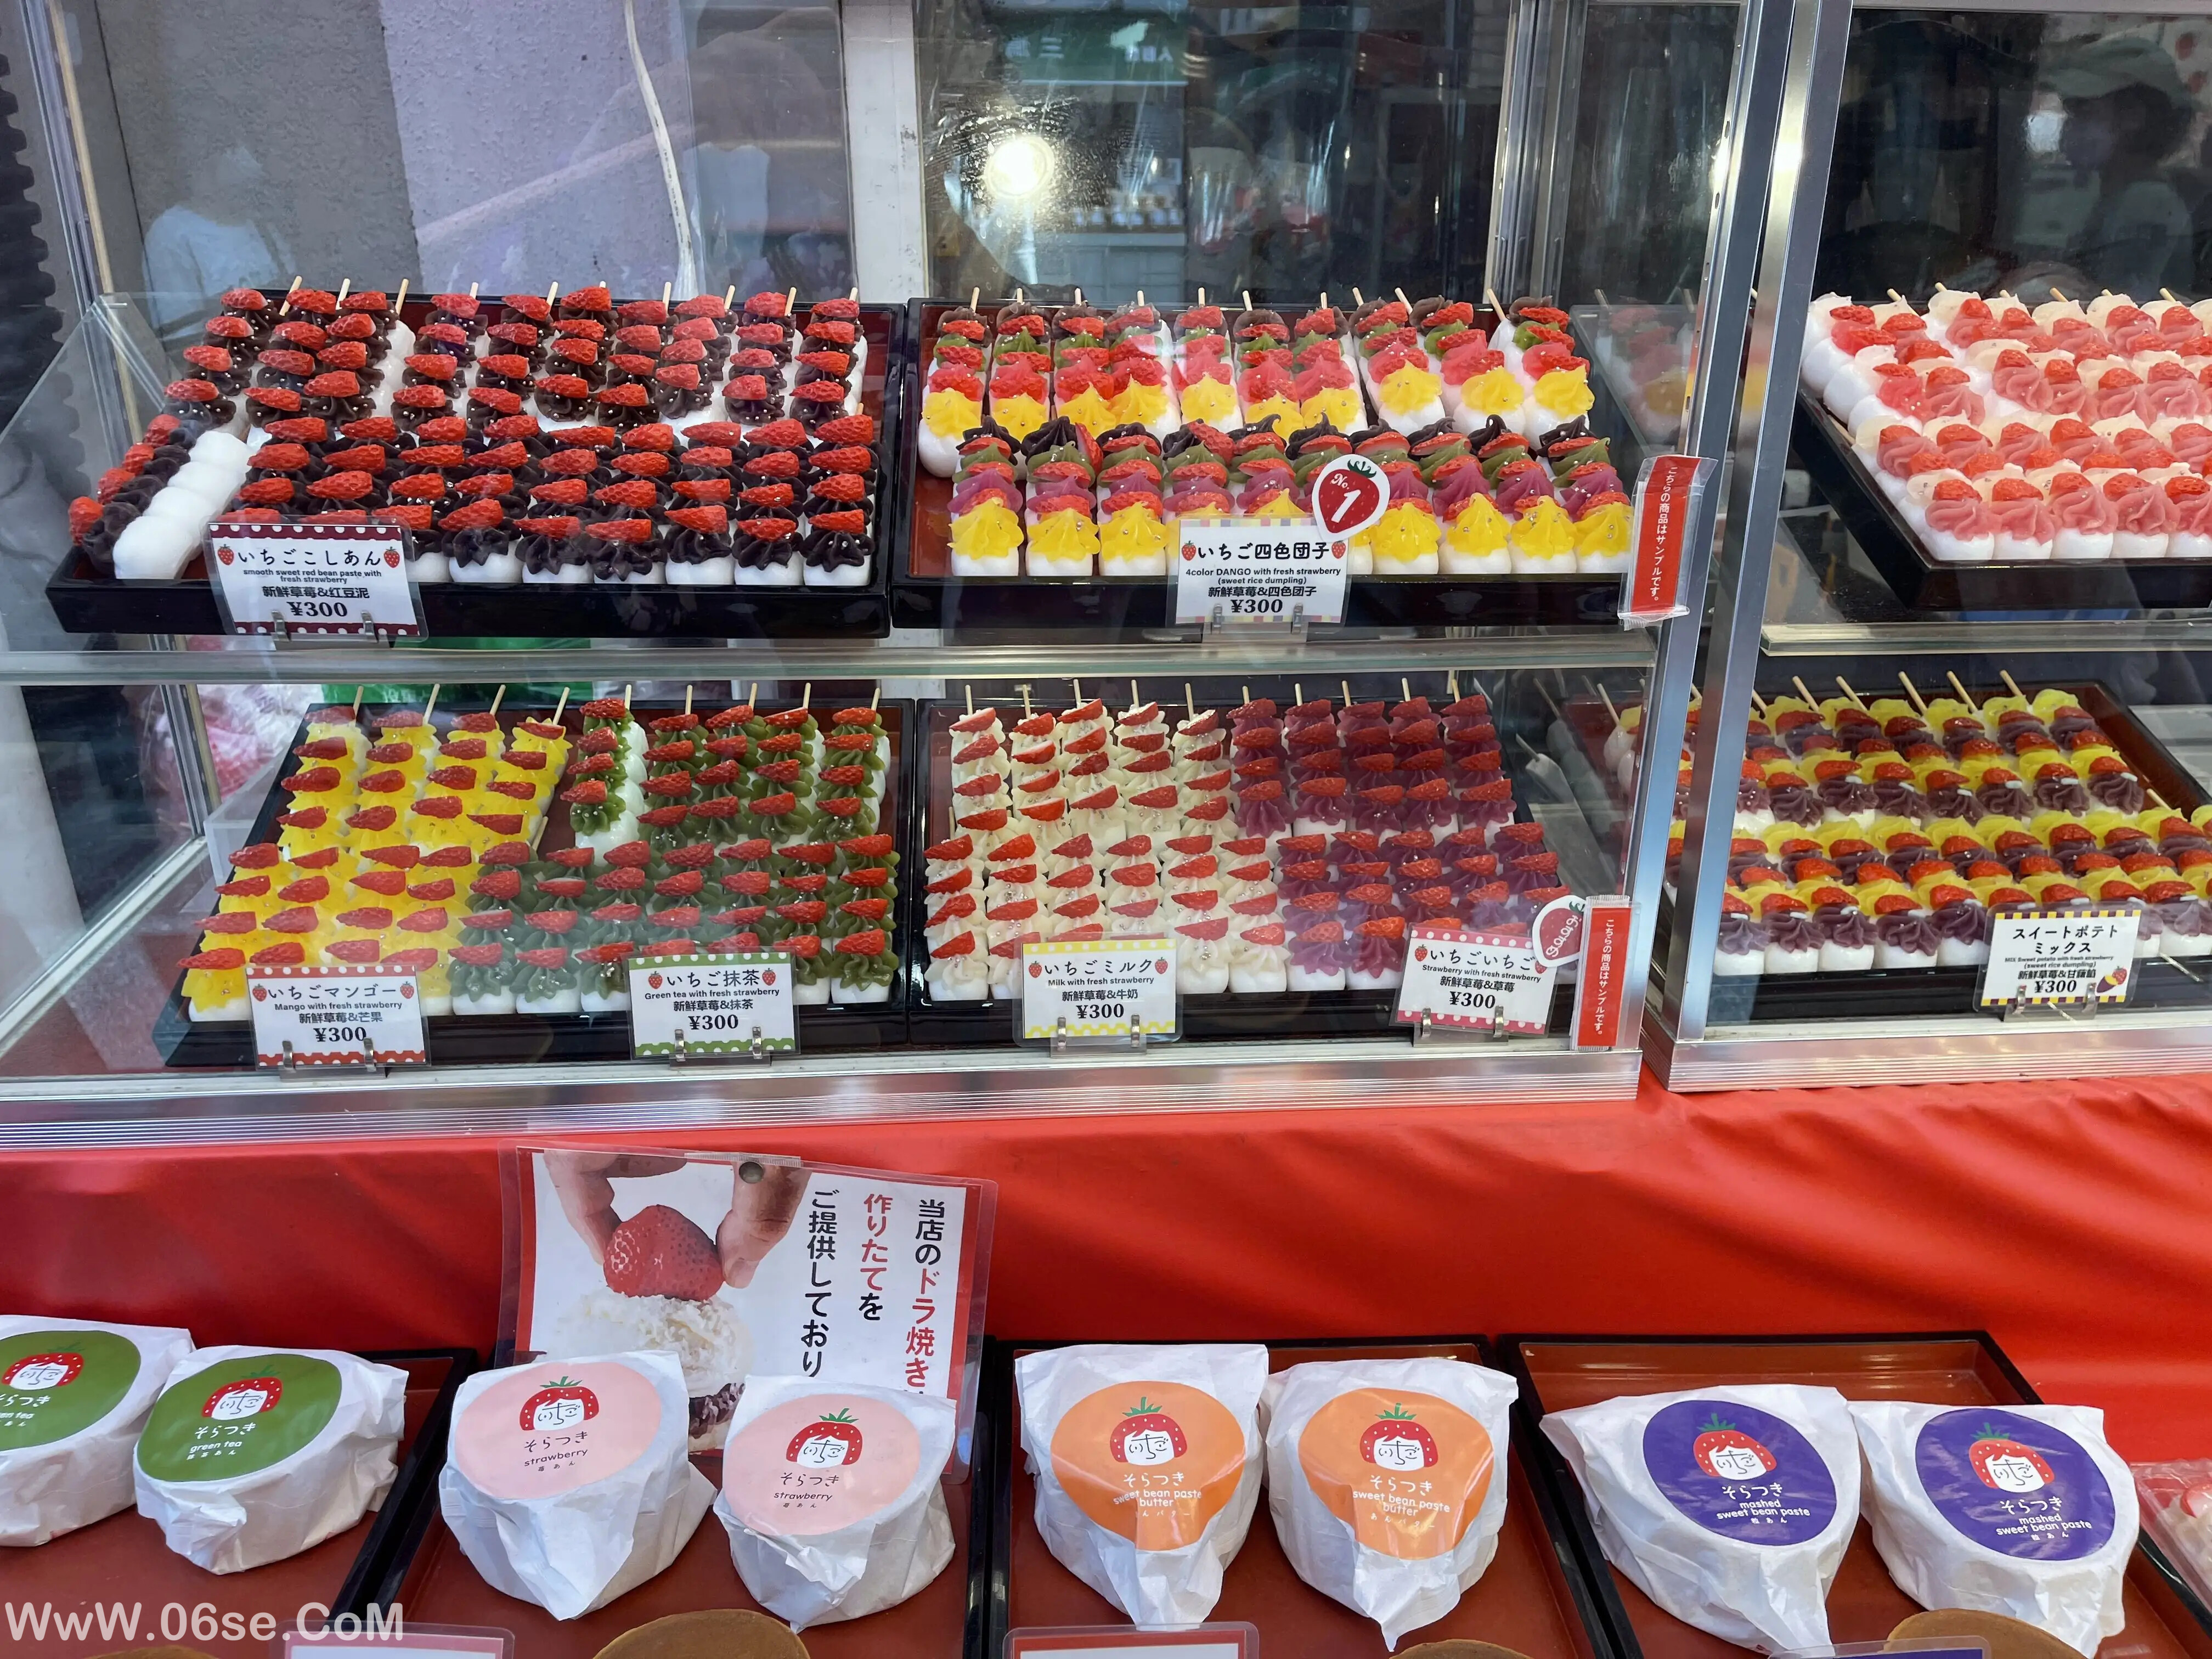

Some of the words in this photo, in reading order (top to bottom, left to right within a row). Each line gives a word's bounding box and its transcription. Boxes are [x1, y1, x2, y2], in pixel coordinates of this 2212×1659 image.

[1331, 472, 1350, 490] No.
[1330, 489, 1361, 523] 1
[1650, 466, 1678, 601] こちらの商品はサンプルです。
[238, 548, 381, 566] いちごこしあん
[1198, 541, 1329, 561] いちご四色団子
[1186, 568, 1214, 577] 4color
[1216, 568, 1251, 576] DANGO
[1273, 567, 1294, 575] fresh
[1296, 567, 1341, 576] strawberry
[1218, 577, 1246, 585] (sweet
[1265, 577, 1307, 585] dumpling)
[287, 602, 348, 617] ¥300
[1231, 599, 1283, 613] ¥300
[1546, 915, 1582, 957] おすすめ
[2013, 924, 2118, 939] スイートポテト
[2035, 942, 2091, 955] ミックス
[1045, 958, 1152, 975] いちごミルク
[1430, 948, 1536, 970] いちごいちご
[667, 969, 759, 988] いちご抹茶
[1423, 964, 1462, 975] Strawberry
[1501, 972, 1541, 983] strawberry
[1594, 919, 1614, 1035] こちらの商品はサンプルです。
[268, 983, 396, 1000] いちごマンゴー
[733, 988, 780, 996] strawberry
[2034, 980, 2077, 993] ¥300
[354, 1001, 402, 1010] strawberry
[1449, 991, 1495, 1009] ¥300
[1076, 1003, 1124, 1019] ¥300
[688, 1014, 738, 1030] ¥300
[313, 1026, 366, 1042] ¥300
[859, 1193, 893, 1321] 作りたてを
[800, 1189, 840, 1378] ご提供しており
[905, 1199, 945, 1394] 当店のドラ焼き
[195, 1423, 256, 1439] そらつき
[189, 1443, 221, 1454] green
[524, 1431, 588, 1452] そらつき
[524, 1449, 588, 1466] strawberry
[780, 1472, 839, 1487] そらつき
[1124, 1471, 1184, 1487] そらつき
[1370, 1475, 1432, 1496] そらつき
[774, 1492, 832, 1501] strawberry
[1113, 1490, 1139, 1505] sweet
[1143, 1489, 1170, 1498] bean
[1174, 1490, 1201, 1499] paste
[1722, 1482, 1782, 1500] そらつき
[1139, 1498, 1173, 1507] butter
[1353, 1491, 1385, 1500] sweet
[1389, 1494, 1415, 1506] bean
[1419, 1500, 1450, 1513] paste
[1383, 1503, 1418, 1516] butter
[1739, 1499, 1781, 1509] mashed
[2000, 1496, 2062, 1515] そらつき
[1717, 1509, 1748, 1519] sweet
[1751, 1508, 1778, 1516] bean
[1781, 1508, 1810, 1517] paste
[2019, 1514, 2062, 1525] mashed
[1996, 1525, 2029, 1536] sweet
[2030, 1523, 2058, 1532] bean
[2062, 1520, 2092, 1531] paste
